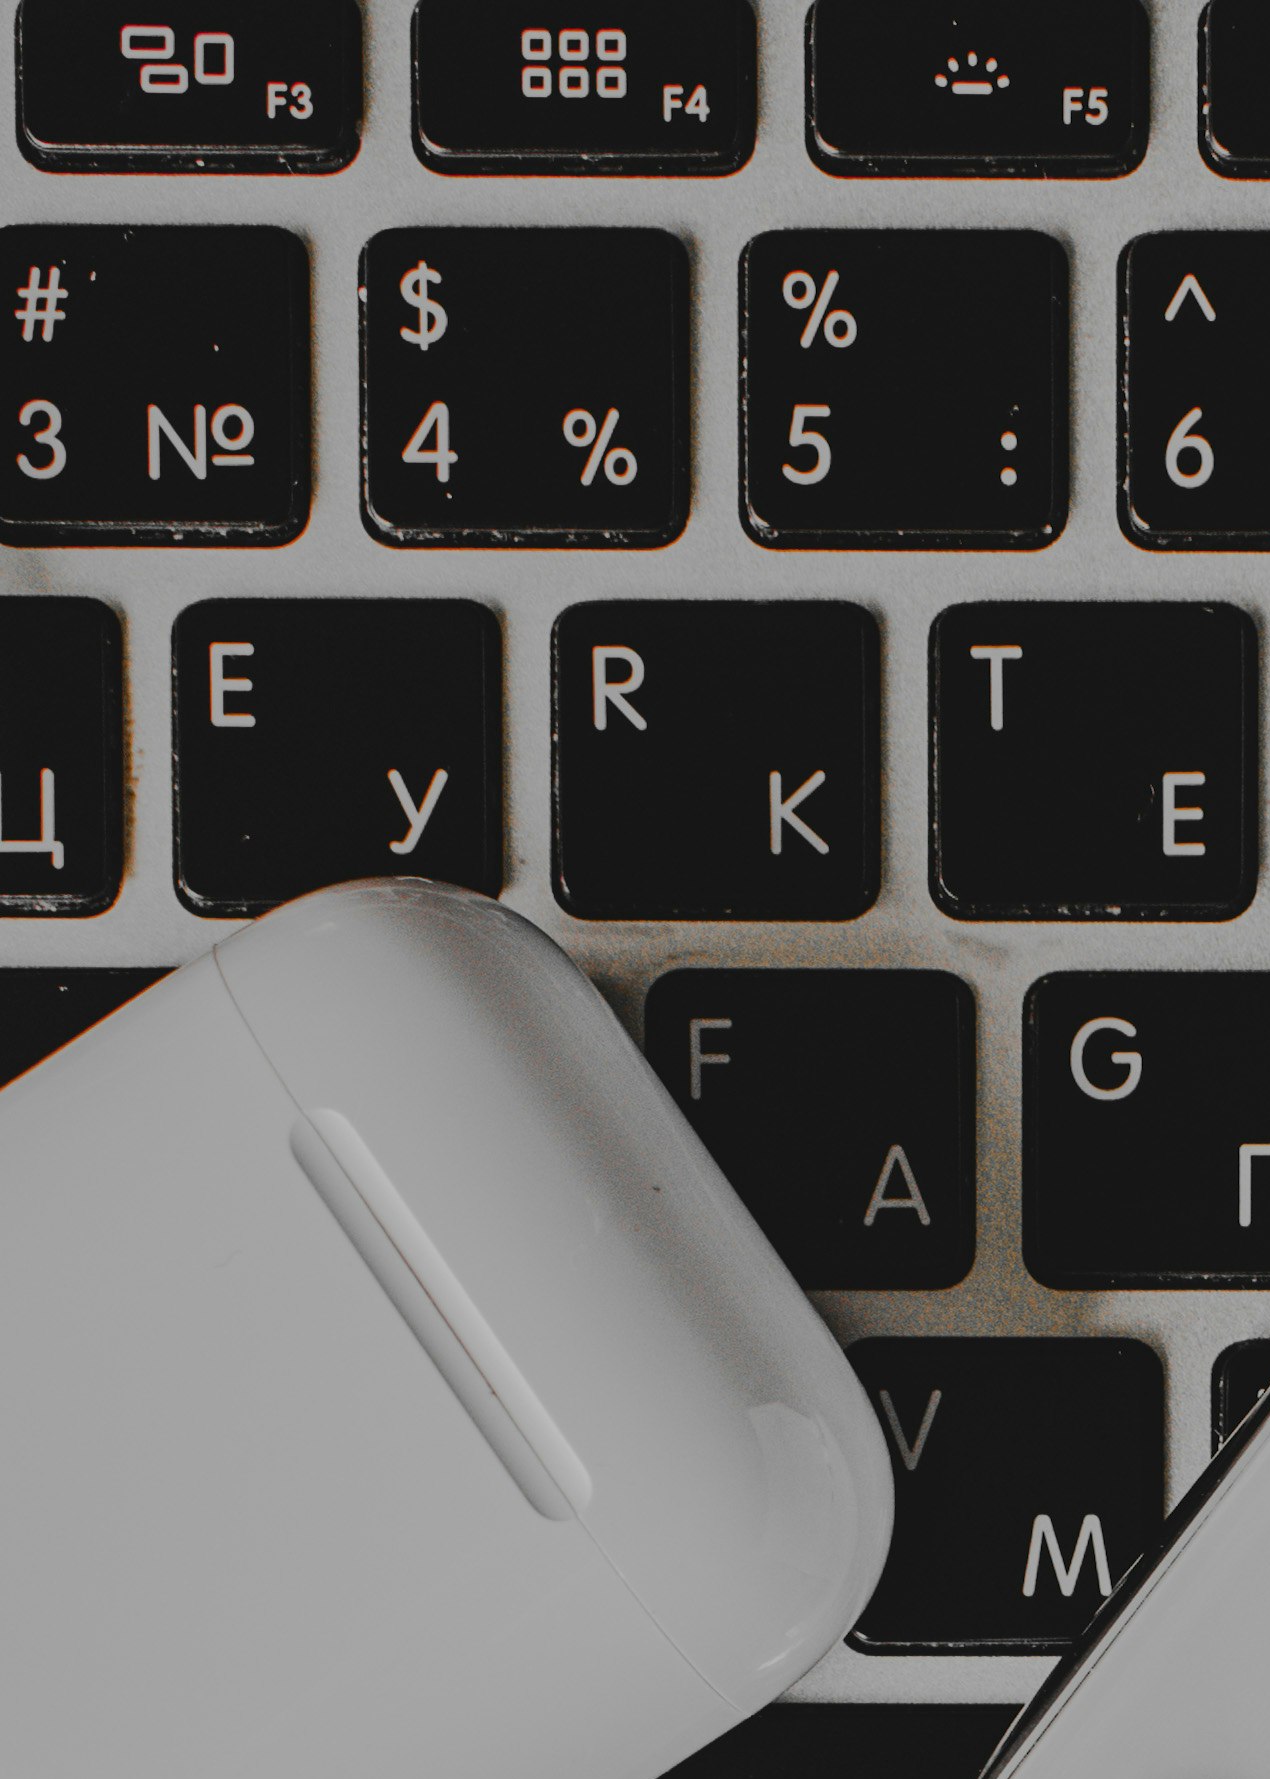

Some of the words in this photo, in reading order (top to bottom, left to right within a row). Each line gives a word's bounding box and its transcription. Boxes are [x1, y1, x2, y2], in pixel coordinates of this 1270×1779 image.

[268, 83, 313, 119] F3
[664, 85, 710, 122] F4
[1063, 89, 1108, 125] F5
[15, 267, 68, 342] #
[400, 261, 448, 351] $
[783, 271, 857, 348] %
[17, 400, 66, 479] 3
[402, 402, 458, 482] 4
[563, 408, 637, 486] %
[783, 405, 831, 485] 5
[1166, 408, 1214, 488] 6
[210, 643, 256, 727] E
[593, 646, 647, 730] R
[970, 646, 1022, 730] T
[691, 1019, 732, 1099] F
[1071, 1018, 1142, 1100] G
[879, 1390, 941, 1471] V
